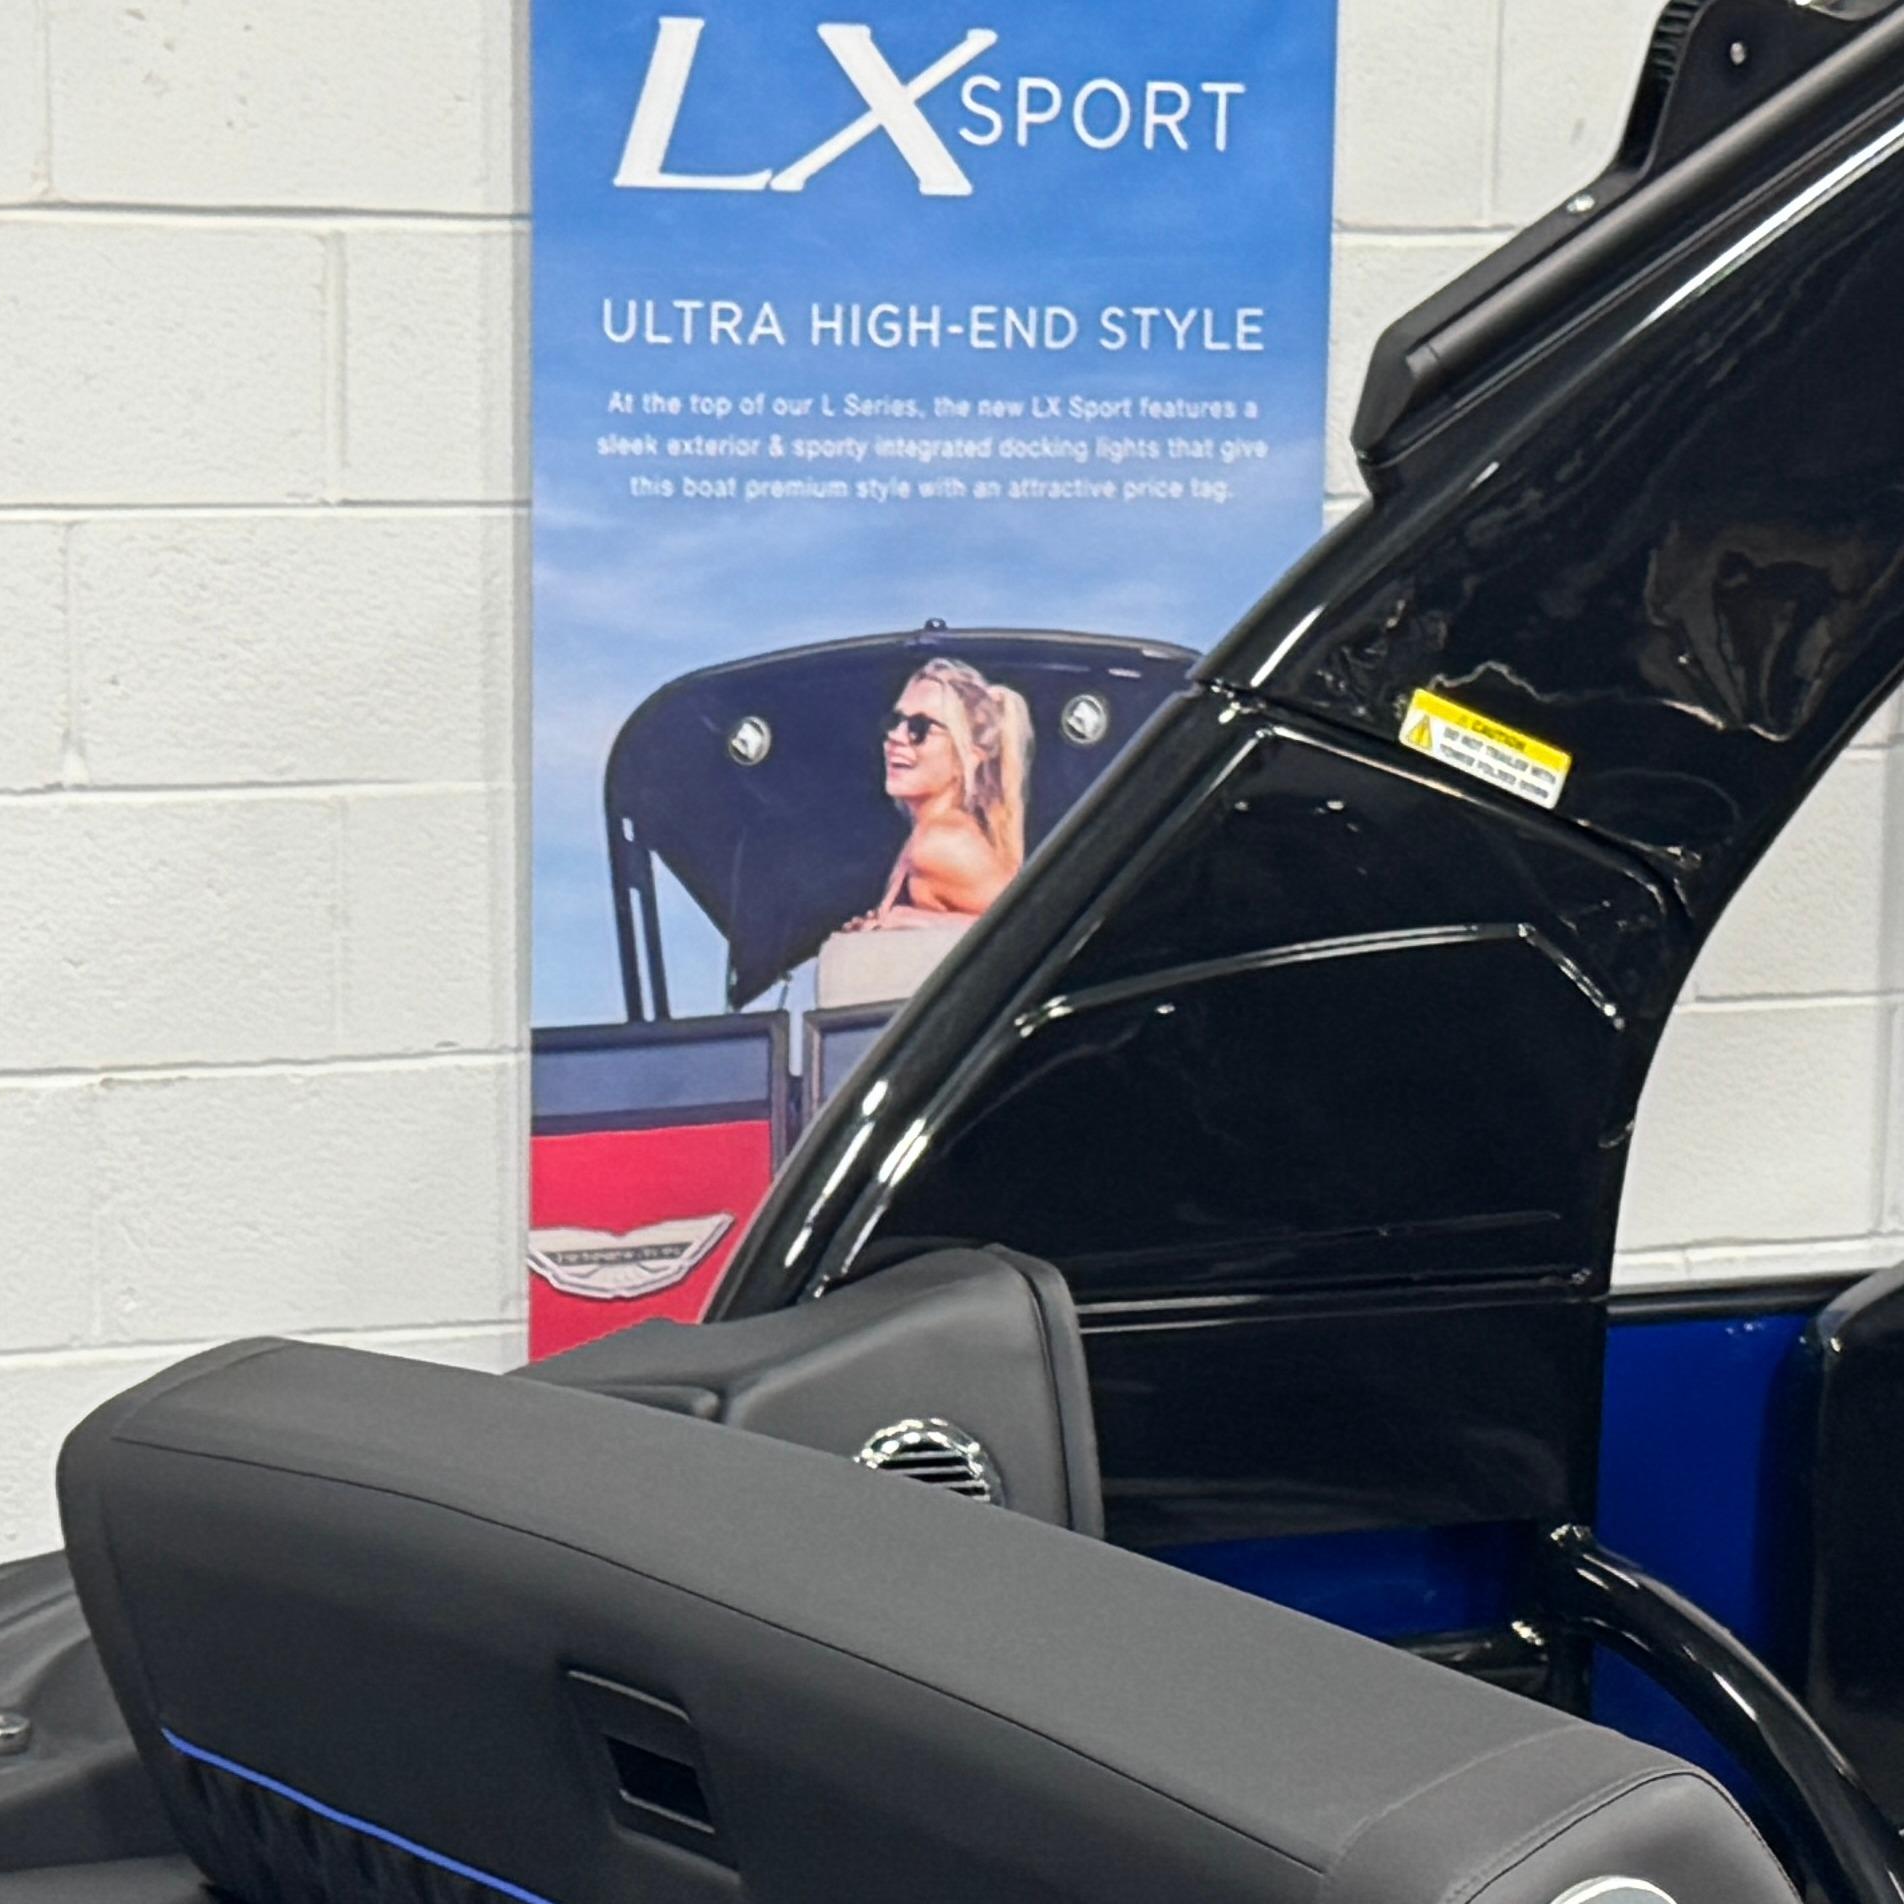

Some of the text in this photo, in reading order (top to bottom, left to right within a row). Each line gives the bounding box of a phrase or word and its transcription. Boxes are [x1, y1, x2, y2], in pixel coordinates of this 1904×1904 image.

[613, 16, 1247, 196] LX SPORT
[604, 299, 1264, 350] ULTRA HIGH-END STYLE
[608, 392, 1258, 422] At the top of our L Series, the new LX Sport features a
[597, 434, 1269, 463] sleek exterior & sporty integrated docking lights that give
[630, 476, 1234, 504] this boat premium style with an attractive price tag.
